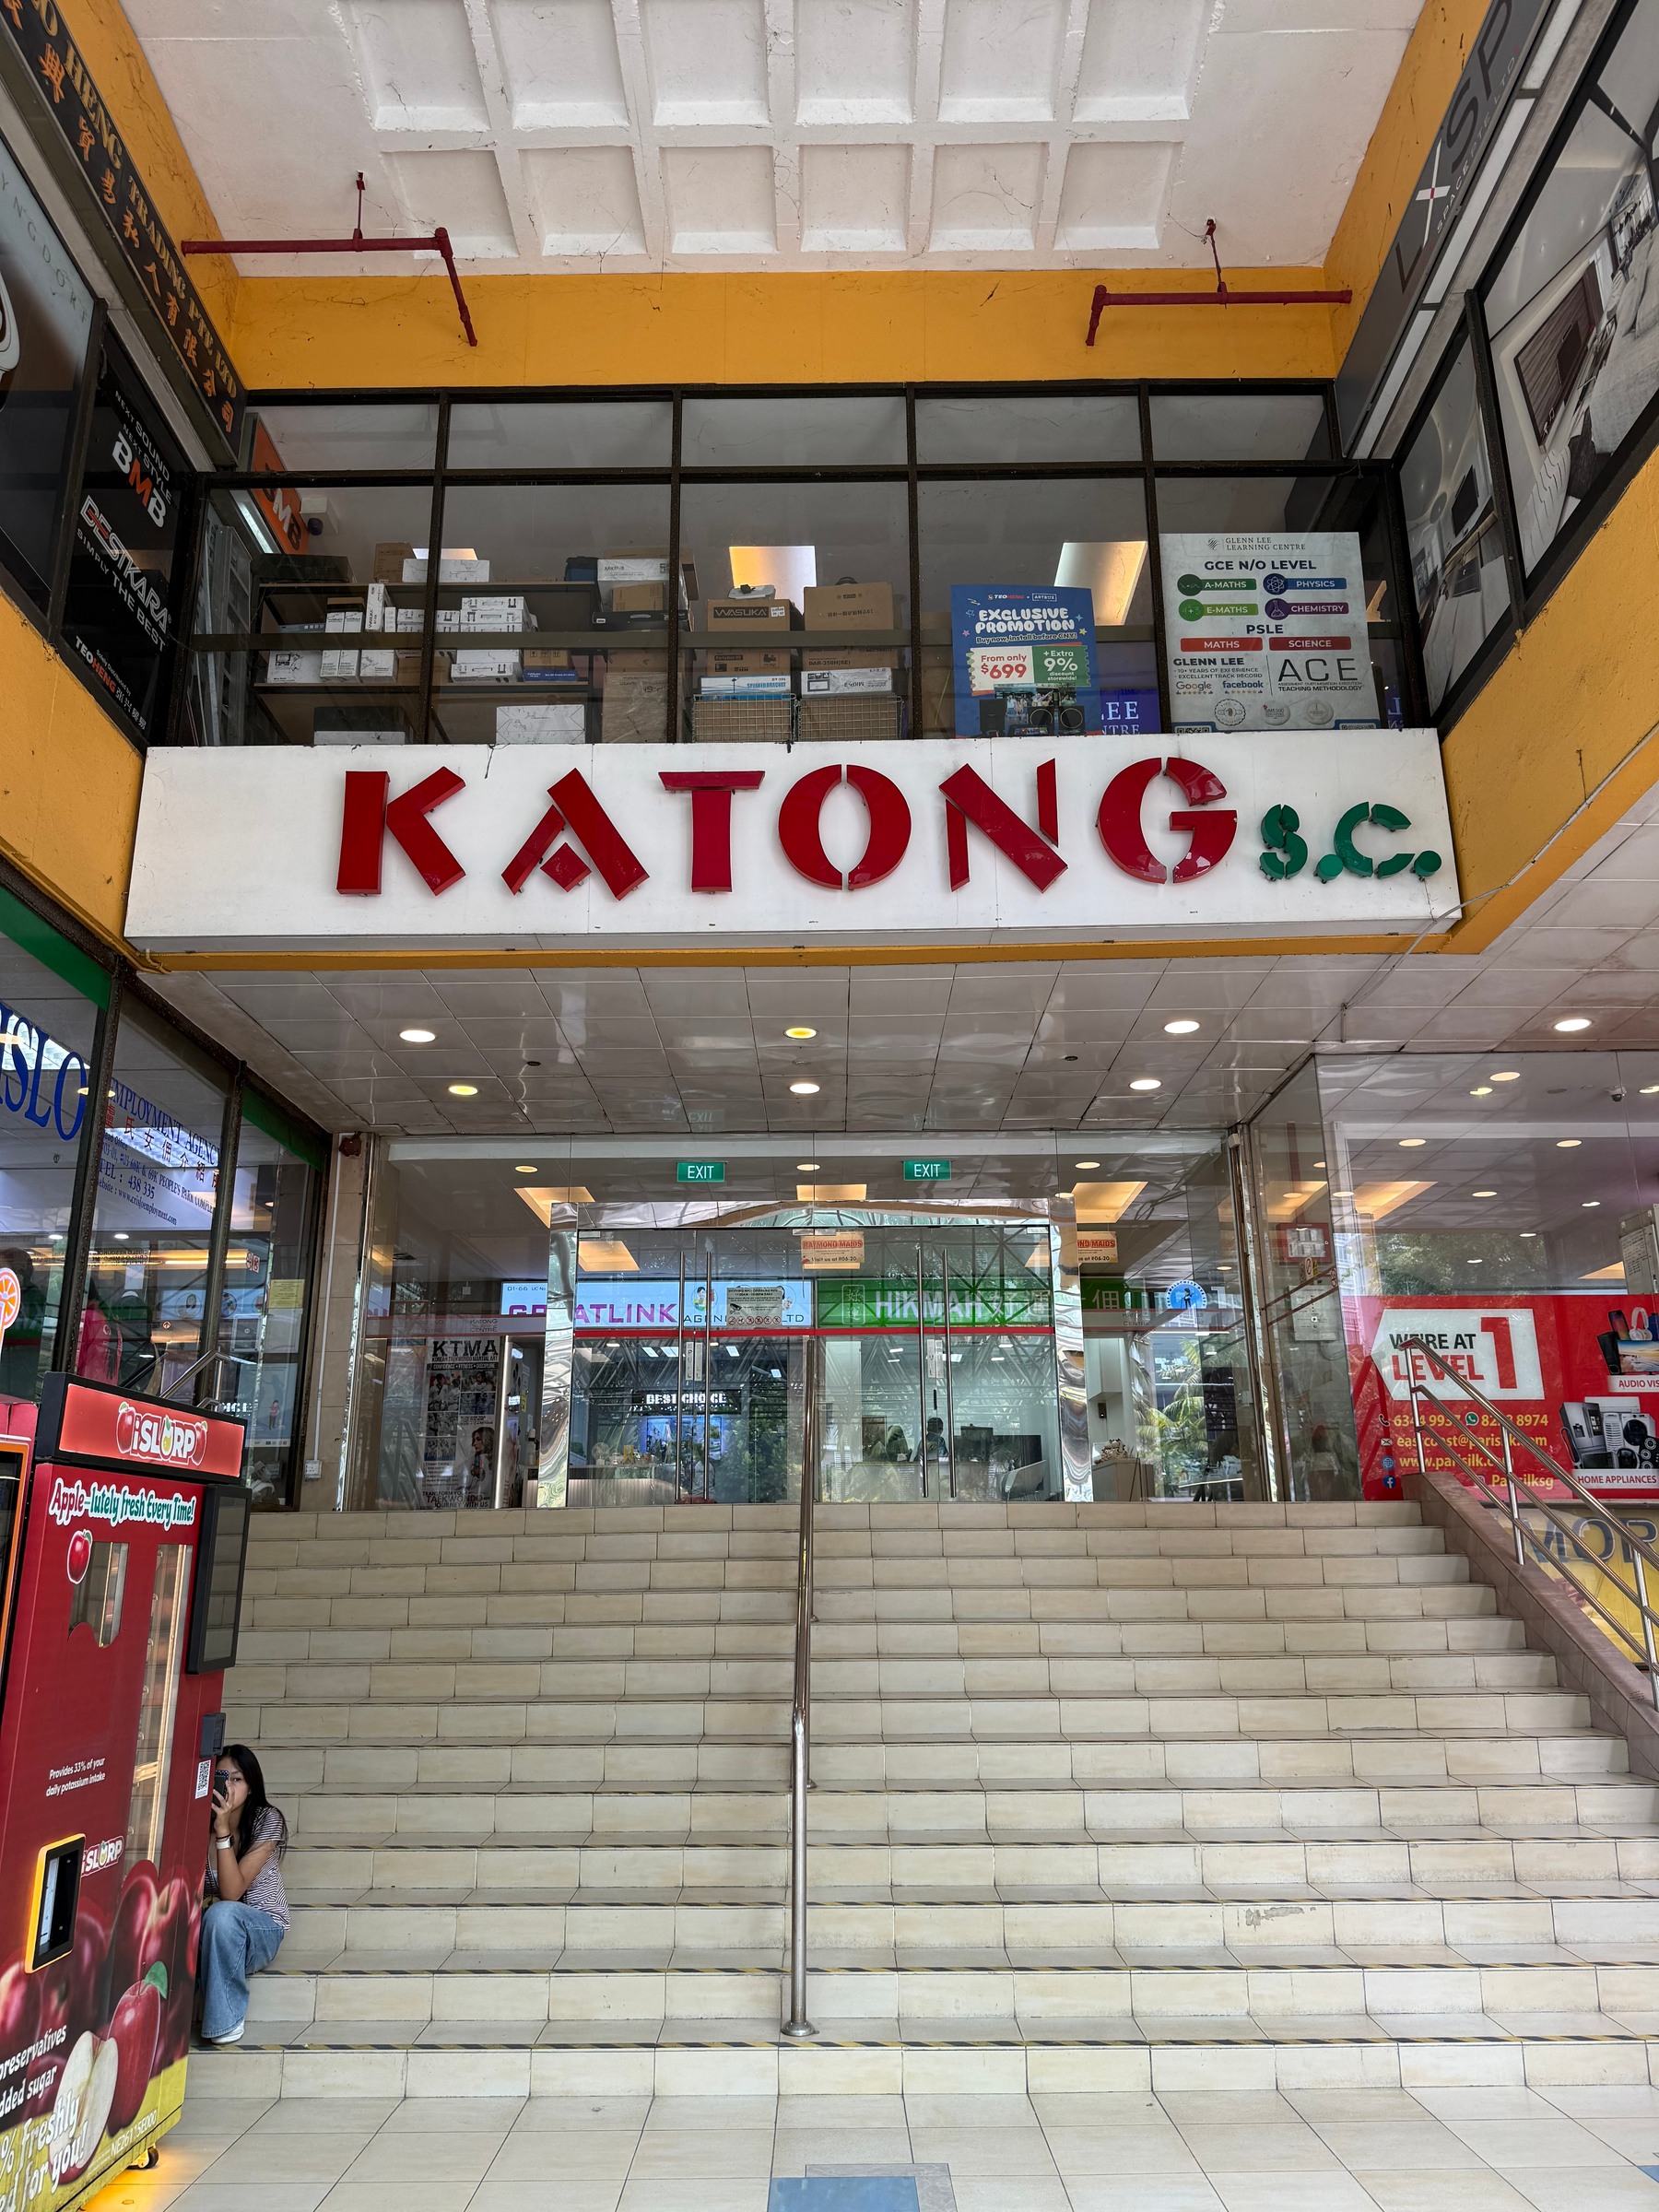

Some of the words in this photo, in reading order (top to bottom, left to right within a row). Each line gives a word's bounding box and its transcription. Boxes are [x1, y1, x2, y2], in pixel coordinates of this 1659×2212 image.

[1437, 160, 1469, 234] SPACE
[1470, 111, 1491, 159] PTE
[1494, 57, 1515, 105] LTD
[64, 40, 123, 170] HENG
[128, 175, 185, 300] TRADING
[188, 297, 213, 356] PTE
[215, 350, 237, 398] LTD
[115, 390, 135, 422] NEXT
[135, 421, 170, 481] SOUND
[123, 424, 142, 455] NEXT
[143, 453, 172, 505] STYLE
[112, 430, 166, 528] BMB
[1205, 561, 1233, 571] GCE
[1239, 559, 1265, 571] N/O
[1271, 560, 1316, 570] LEVEL
[77, 528, 109, 575] SIMPLY
[112, 571, 135, 612] THE
[136, 606, 166, 652] BEST
[714, 608, 767, 617] WASUKA
[979, 607, 1069, 621] EXCLUSIVE
[975, 619, 1075, 634] PROMOTION
[1246, 625, 1284, 634] PSLE
[1009, 633, 1032, 641] install
[1007, 653, 1027, 664] only
[1043, 658, 1078, 672] 9%
[981, 663, 1027, 679] $699
[1278, 658, 1358, 681] ACE
[1176, 681, 1212, 691] Google
[1222, 680, 1264, 688] facebook
[336, 757, 1237, 900] KATONG
[109, 1077, 182, 1145] EMPLOYMENT
[687, 1166, 714, 1179] EXIT
[913, 1164, 940, 1178] EXIT
[802, 1240, 837, 1249] RAYMOND
[838, 1240, 863, 1248] MAIDS
[1090, 1240, 1115, 1248] MAIDS
[876, 1290, 982, 1318] HIKMAH
[432, 1340, 499, 1357] KTMA
[1453, 1334, 1477, 1349] AT
[1481, 1317, 1518, 1389] 1
[1391, 1355, 1485, 1380] LEVEL
[1618, 1380, 1646, 1388] AUDIO
[646, 1394, 677, 1405] BEST
[682, 1393, 726, 1404] CHOCE
[1516, 1415, 1548, 1427] 8974
[133, 1418, 194, 1460] iSLURP
[1578, 1476, 1604, 1484] HOME
[1605, 1476, 1656, 1484] APPLIANCES
[172, 1495, 196, 1523] Time!
[49, 1766, 74, 1780] Provides
[74, 1762, 86, 1773] 33%
[87, 1759, 94, 1771] of
[93, 1757, 105, 1771] your
[46, 1783, 60, 1797] daily
[61, 1776, 89, 1793] potassium
[89, 1771, 105, 1785] intake
[27, 2065, 57, 2099] sugar
[52, 2121, 88, 2194] you!
